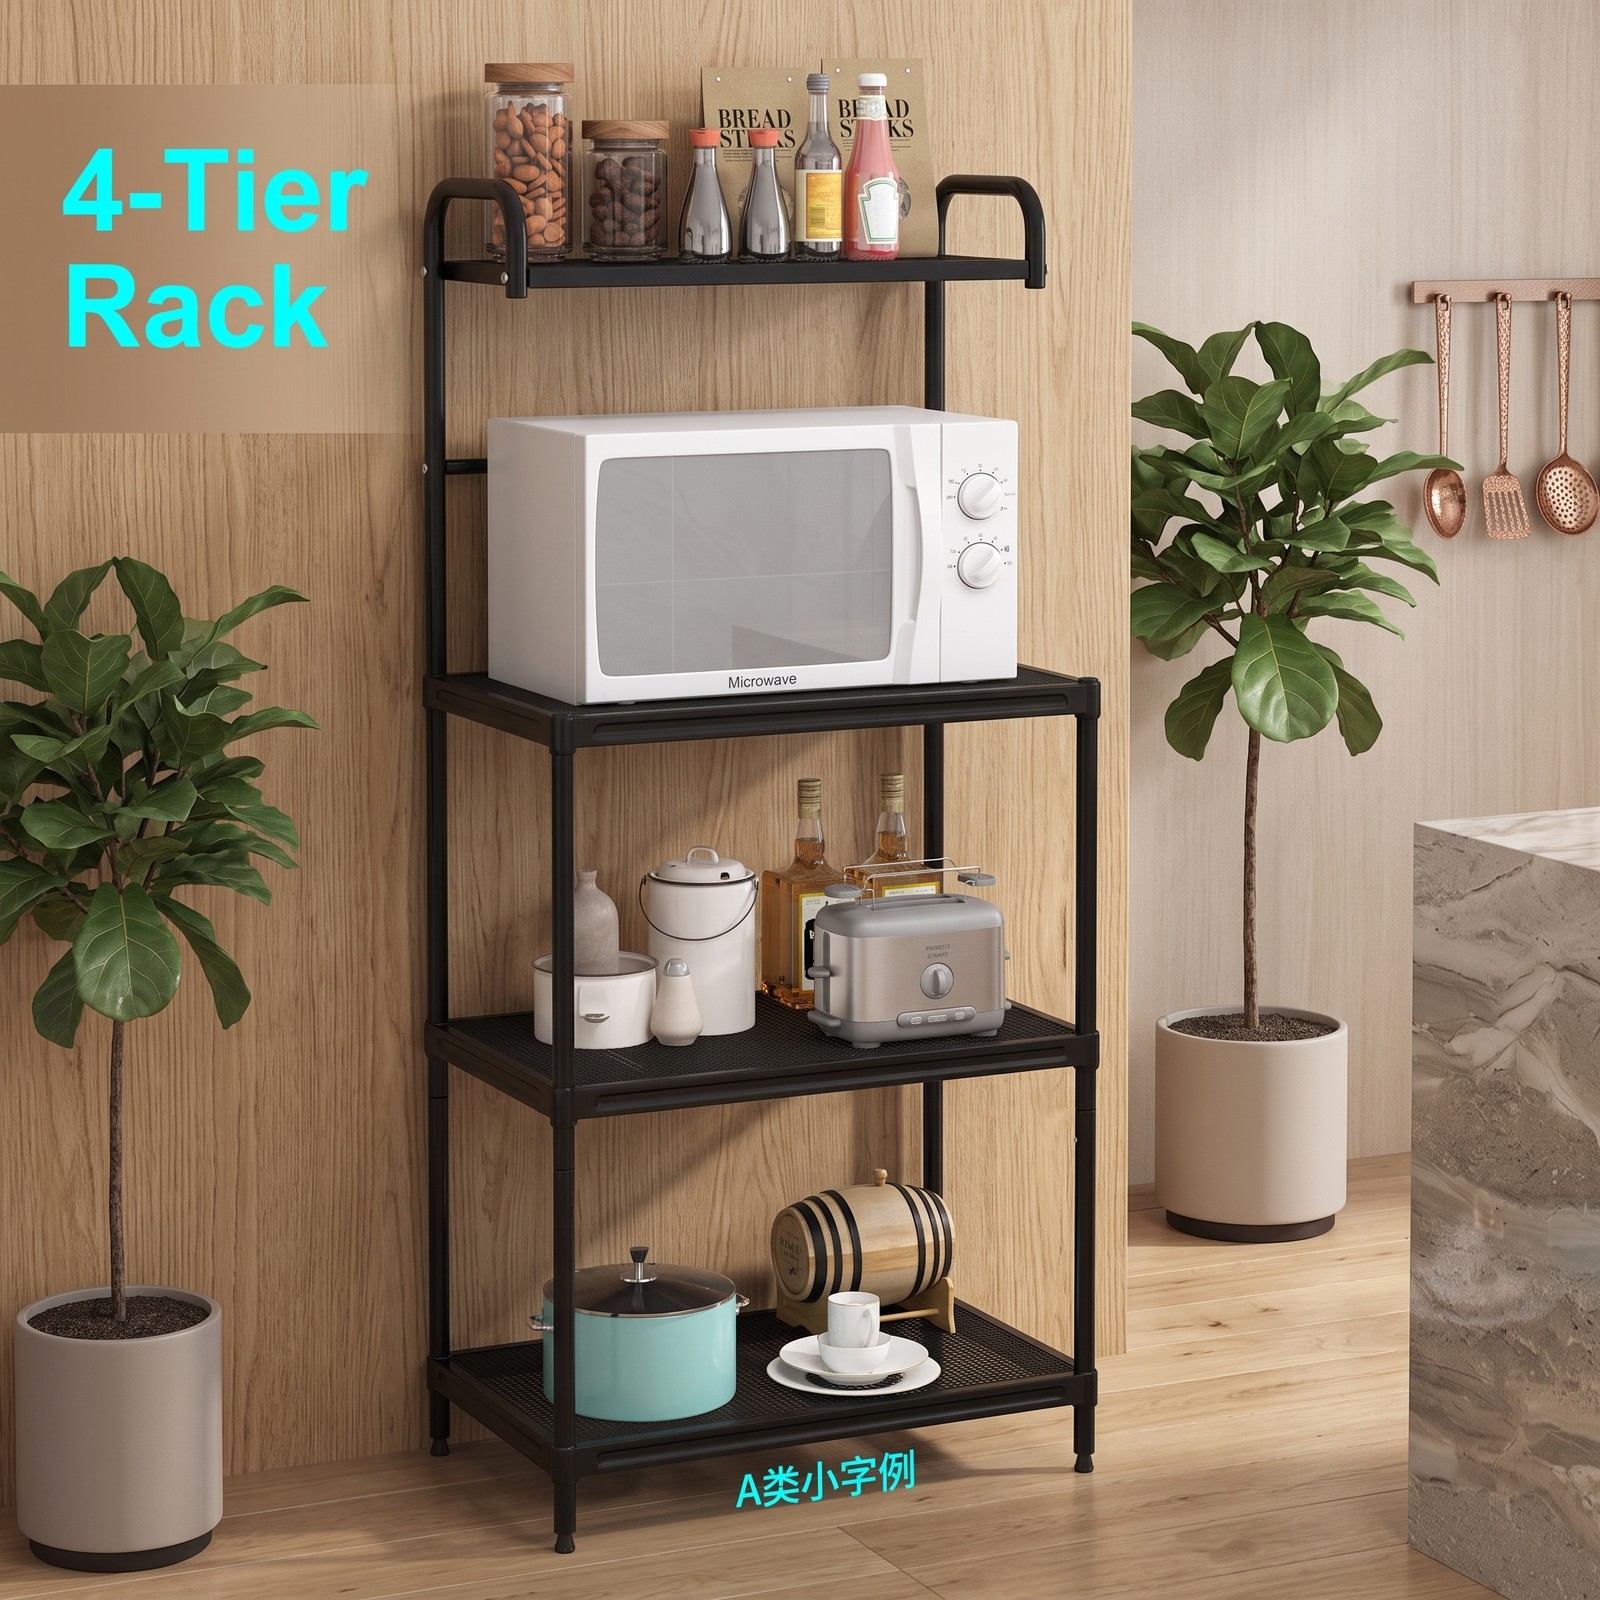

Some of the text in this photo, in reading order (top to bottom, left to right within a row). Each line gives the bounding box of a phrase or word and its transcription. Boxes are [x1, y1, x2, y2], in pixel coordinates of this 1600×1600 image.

[838, 99, 909, 118] BAD
[718, 109, 791, 129] BREAD
[840, 118, 914, 138] SKS
[728, 674, 797, 689] Microwave
